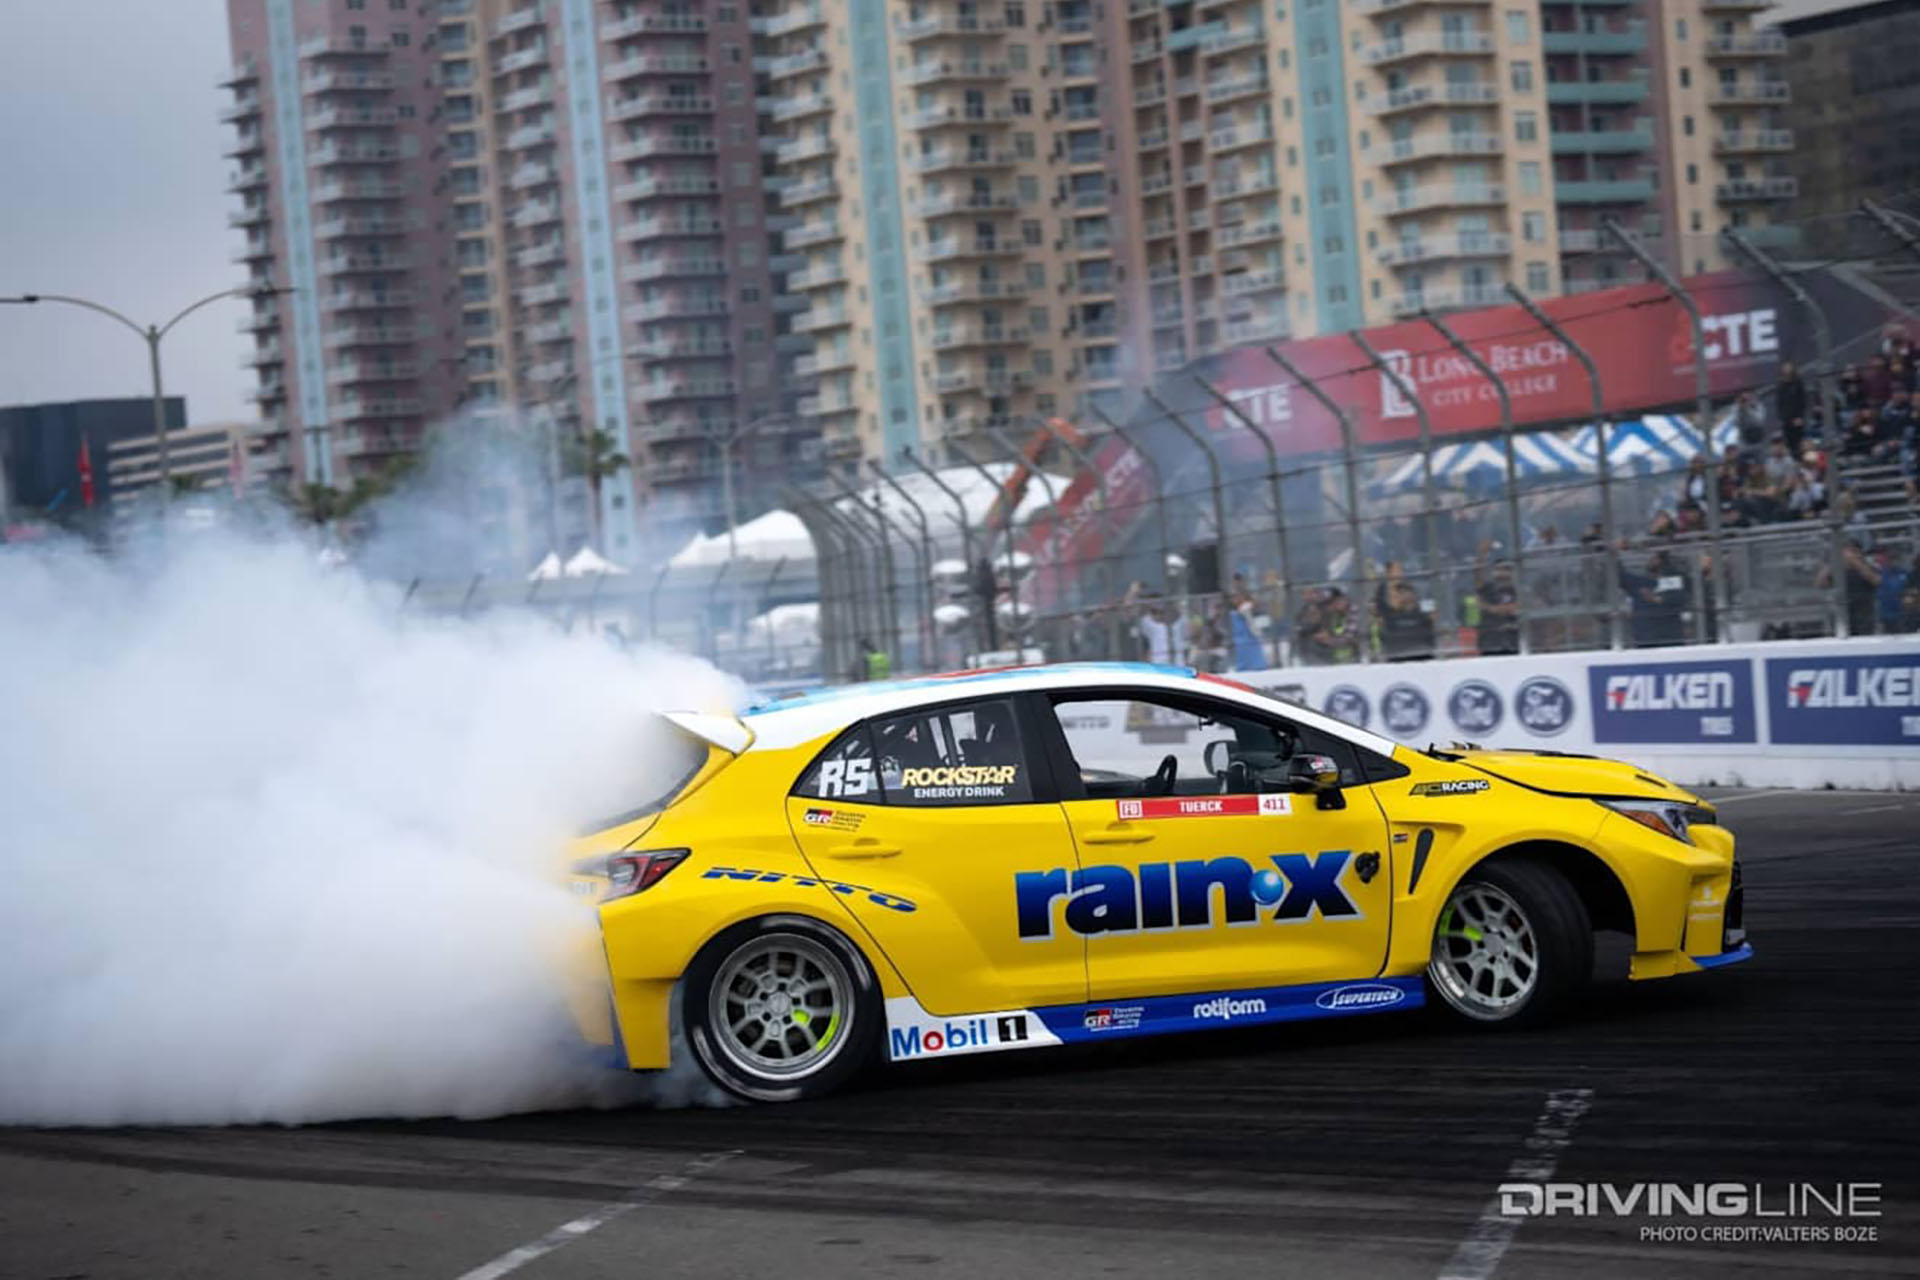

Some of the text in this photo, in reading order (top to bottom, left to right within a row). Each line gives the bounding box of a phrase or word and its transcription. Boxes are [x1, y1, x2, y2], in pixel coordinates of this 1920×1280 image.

[1699, 308, 1779, 360] CTE
[1489, 341, 1569, 372] BEACH
[1223, 383, 1292, 429] CTE
[1605, 671, 1734, 711] FALKEN
[902, 765, 1017, 787] ROCKSTAR
[1441, 780, 1490, 792] RACING
[914, 785, 1005, 799] ENERGY DRINK
[1179, 800, 1224, 813] TUERCK
[1262, 797, 1286, 811] 411
[701, 866, 917, 912] NITTO
[1193, 997, 1267, 1020] rotiform
[1085, 1015, 1111, 1027] GR
[891, 1017, 989, 1057] Mobil
